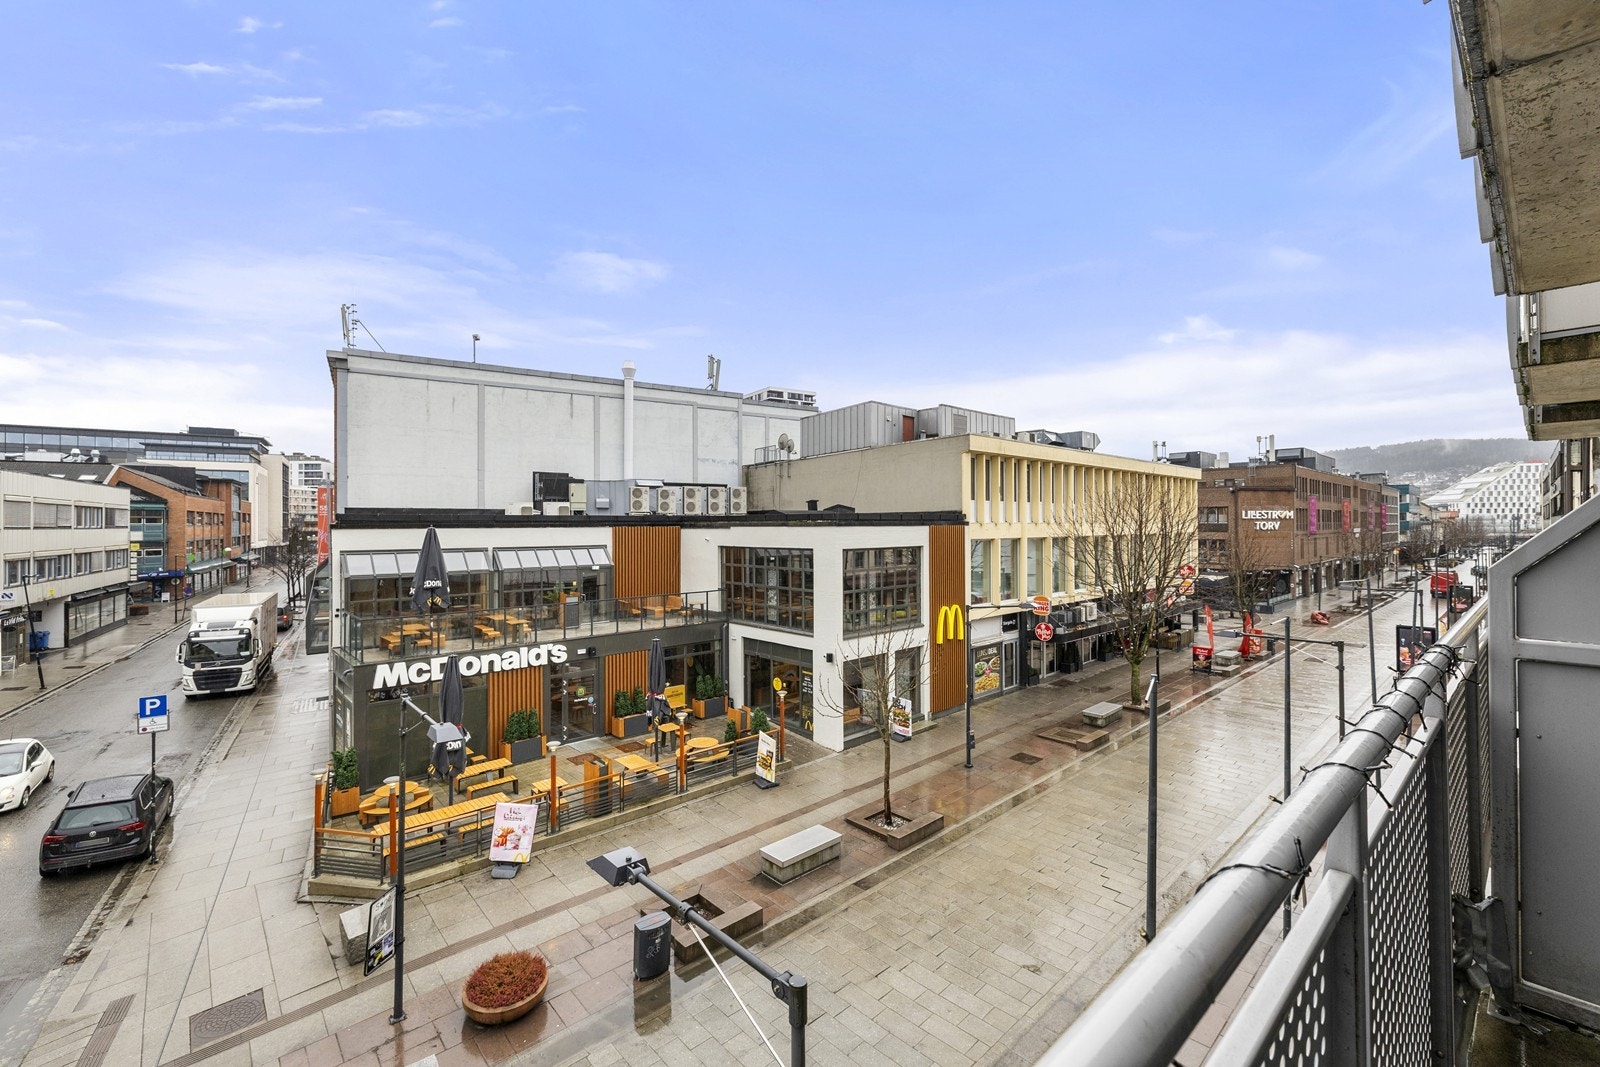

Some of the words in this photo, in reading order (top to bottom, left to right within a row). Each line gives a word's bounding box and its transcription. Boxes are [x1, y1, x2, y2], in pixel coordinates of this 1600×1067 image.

[1255, 521, 1281, 530] TORV
[372, 643, 568, 689] McDonald's
[145, 698, 161, 716] P
